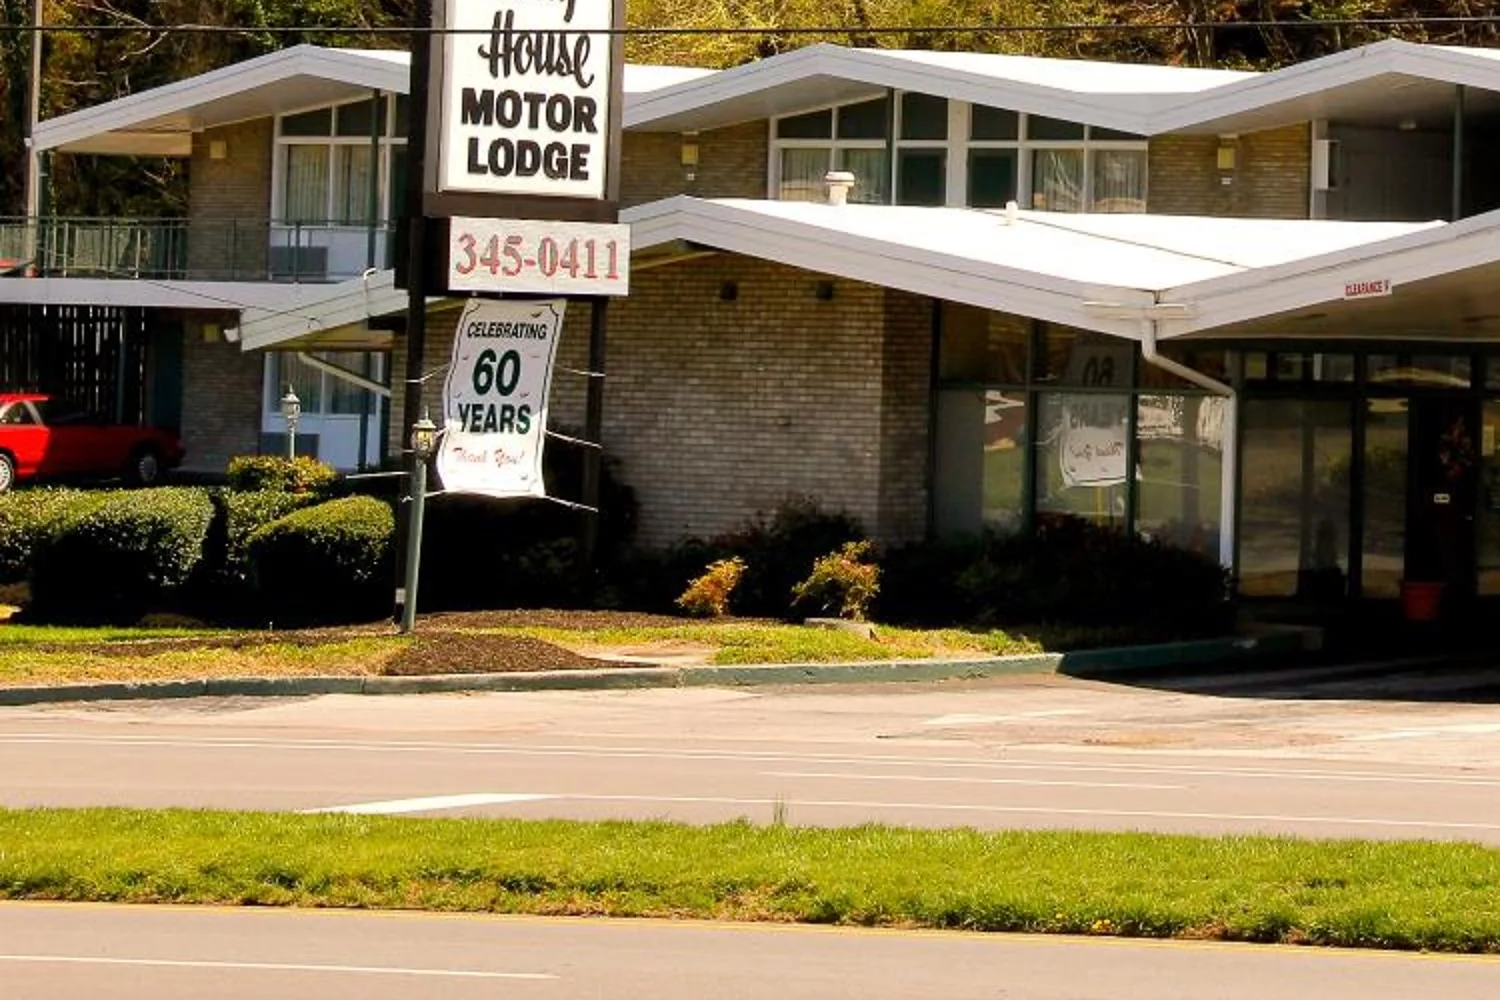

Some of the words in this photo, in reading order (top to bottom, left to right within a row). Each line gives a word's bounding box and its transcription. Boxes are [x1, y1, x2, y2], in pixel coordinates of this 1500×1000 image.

[478, 9, 595, 89] House
[461, 87, 597, 134] MOTOR
[467, 137, 590, 181] LODGE
[456, 233, 619, 280] 345-0411
[467, 321, 548, 340] CELEBRATING
[472, 348, 521, 396] 60
[457, 403, 531, 435] YEARS
